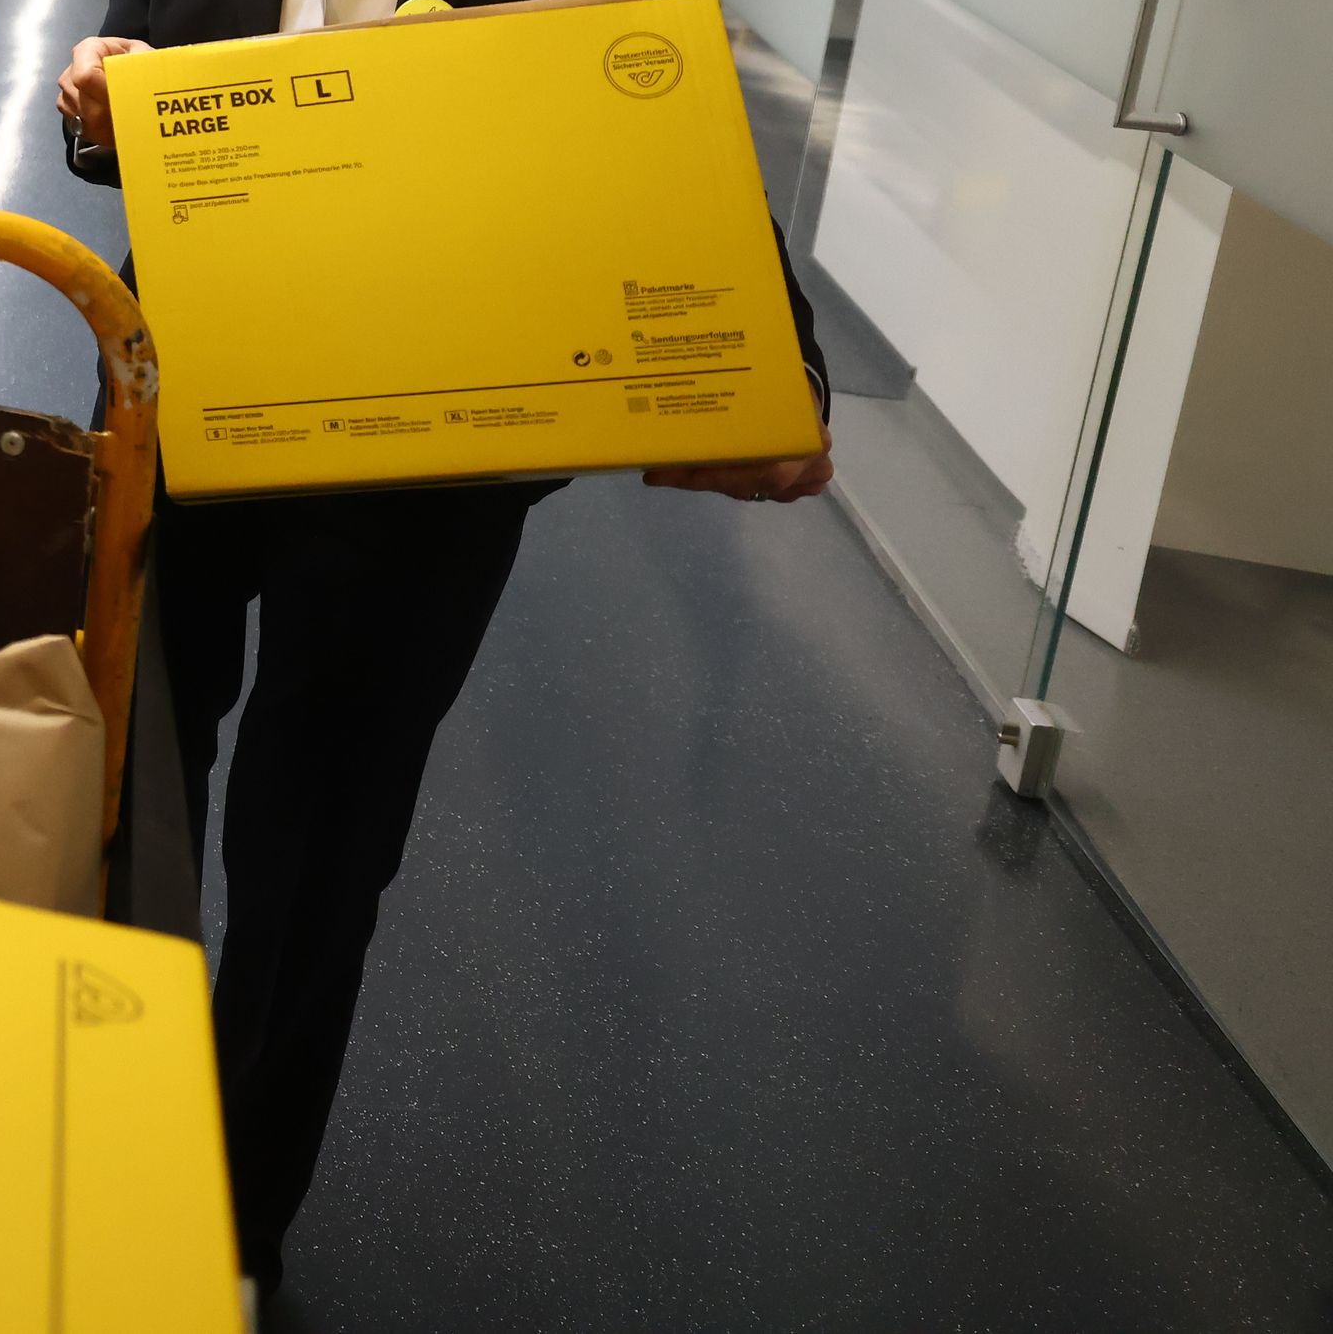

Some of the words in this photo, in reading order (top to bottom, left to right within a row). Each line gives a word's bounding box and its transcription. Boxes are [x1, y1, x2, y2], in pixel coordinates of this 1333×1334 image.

[315, 79, 331, 98] L
[156, 93, 224, 116] PAKET
[230, 87, 275, 107] BOX
[159, 115, 230, 138] LARGE
[641, 283, 695, 294] Paketmarke
